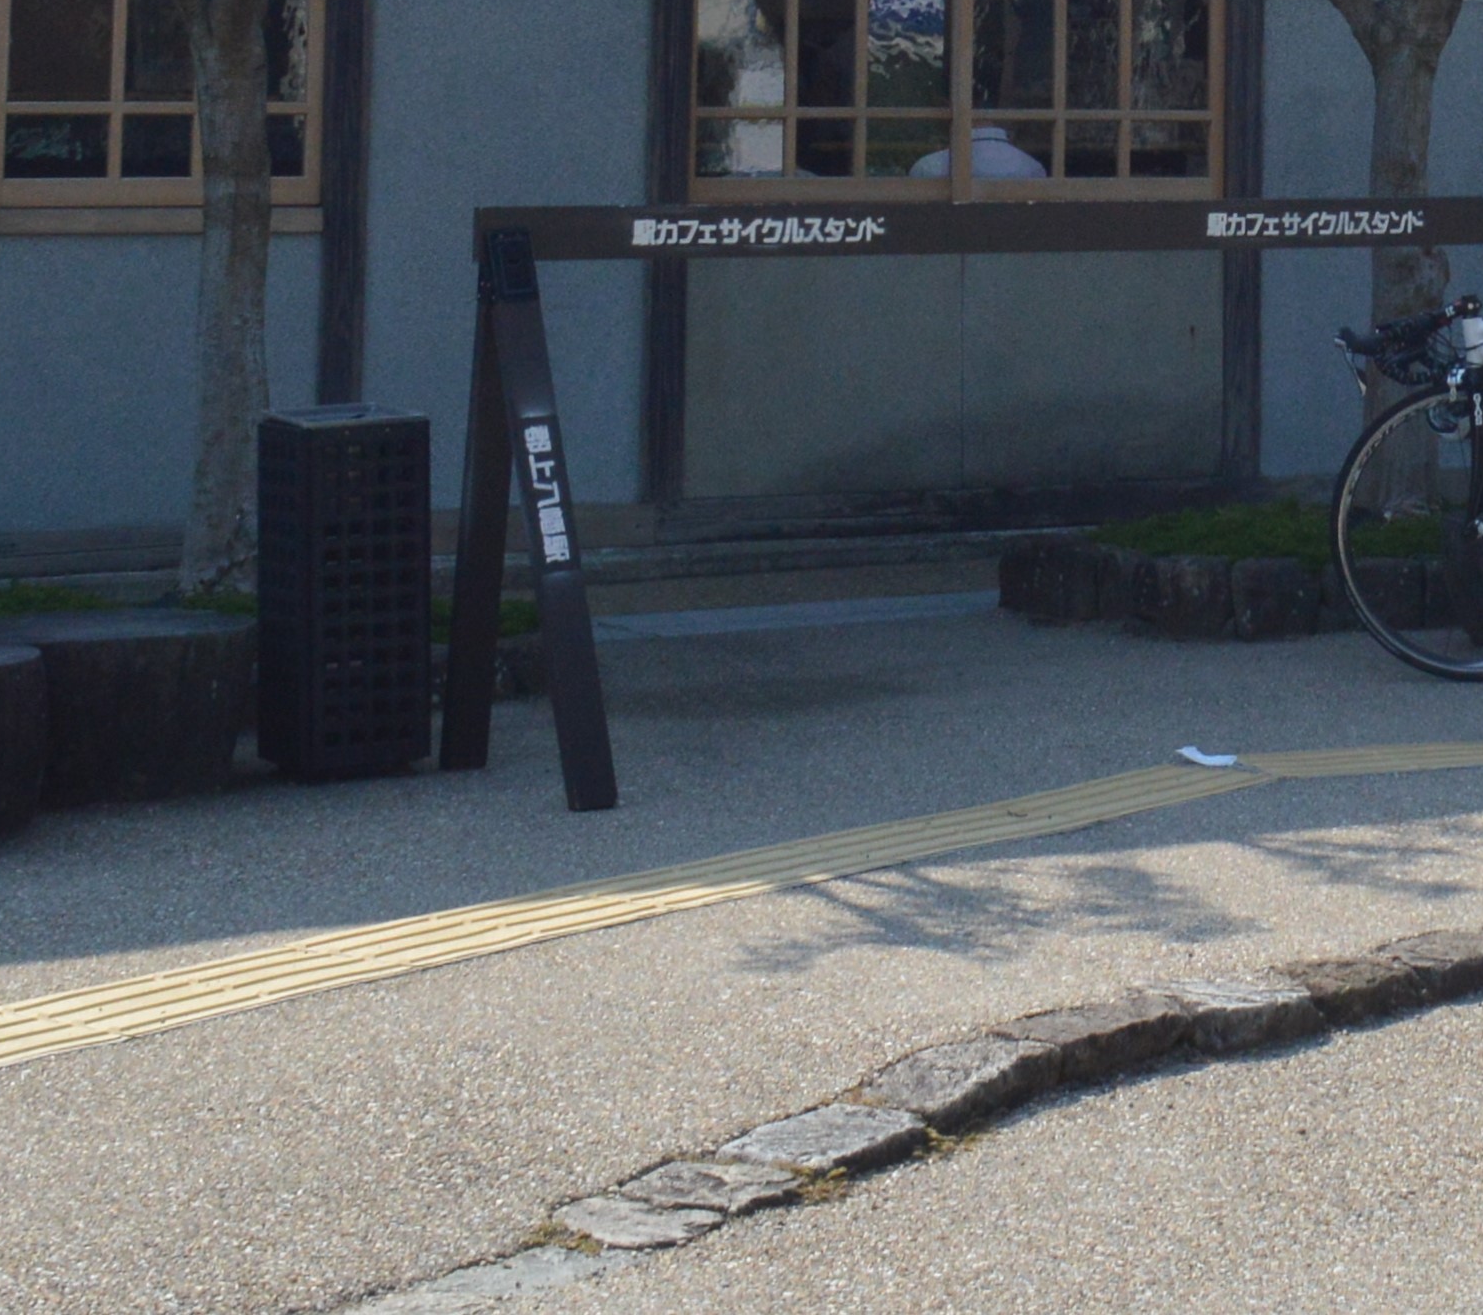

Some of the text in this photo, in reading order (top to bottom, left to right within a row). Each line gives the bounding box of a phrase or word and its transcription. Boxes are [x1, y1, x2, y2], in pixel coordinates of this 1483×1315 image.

[632, 216, 885, 246] 駅カフェサイクルスタンド
[1206, 210, 1424, 237] 駅カフェサイクルスタンド
[523, 424, 570, 564] 郡上八幡駅
